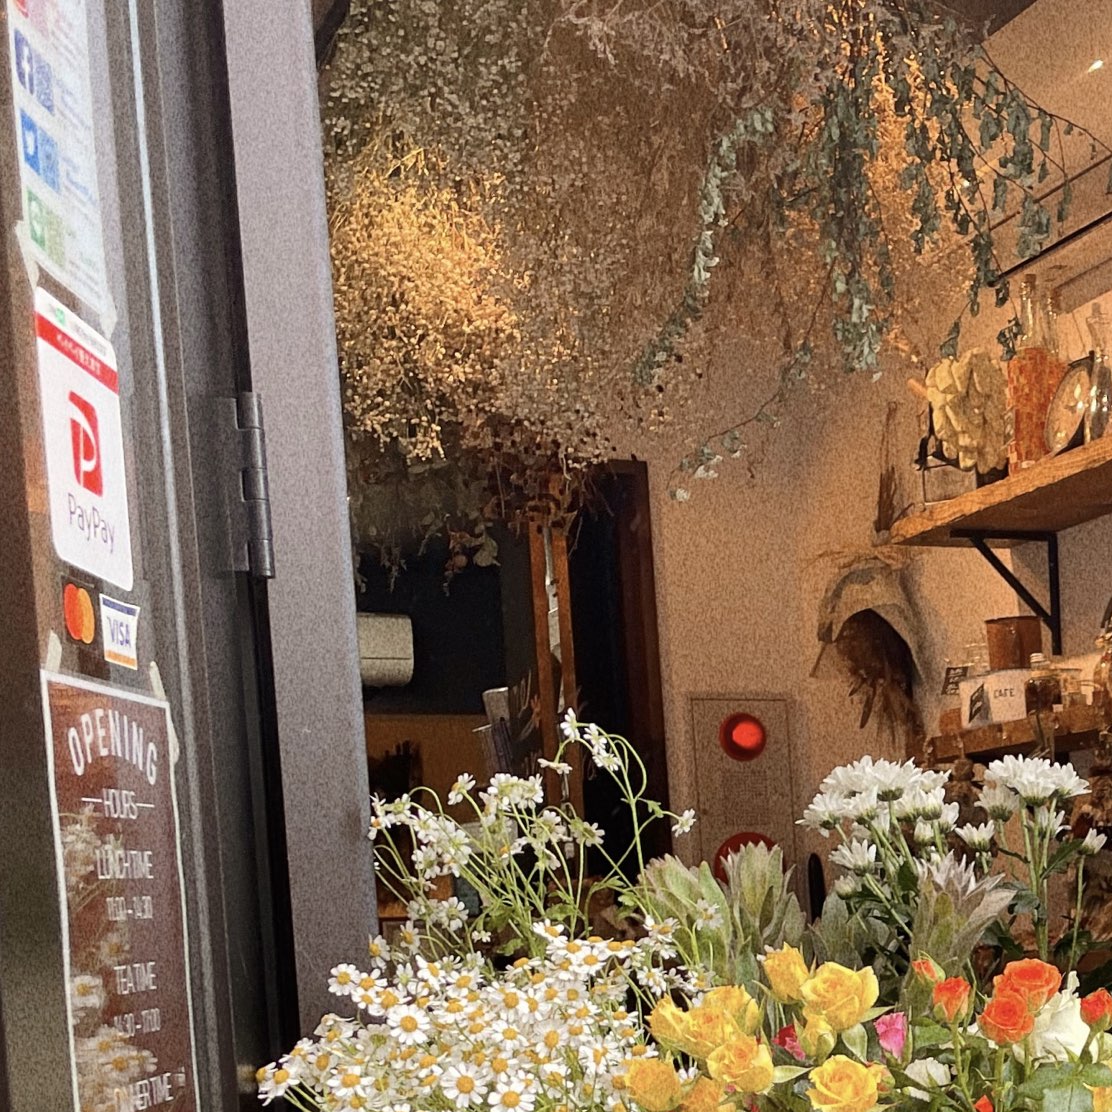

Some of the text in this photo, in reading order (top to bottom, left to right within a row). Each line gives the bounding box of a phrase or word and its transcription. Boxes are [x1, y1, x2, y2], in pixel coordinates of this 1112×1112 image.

[67, 493, 116, 553] PayPay
[107, 616, 132, 647] VISA
[67, 708, 158, 785] OPENING
[102, 788, 138, 820] HOURS
[130, 850, 154, 879] TIME
[114, 961, 158, 996] TEA TIME
